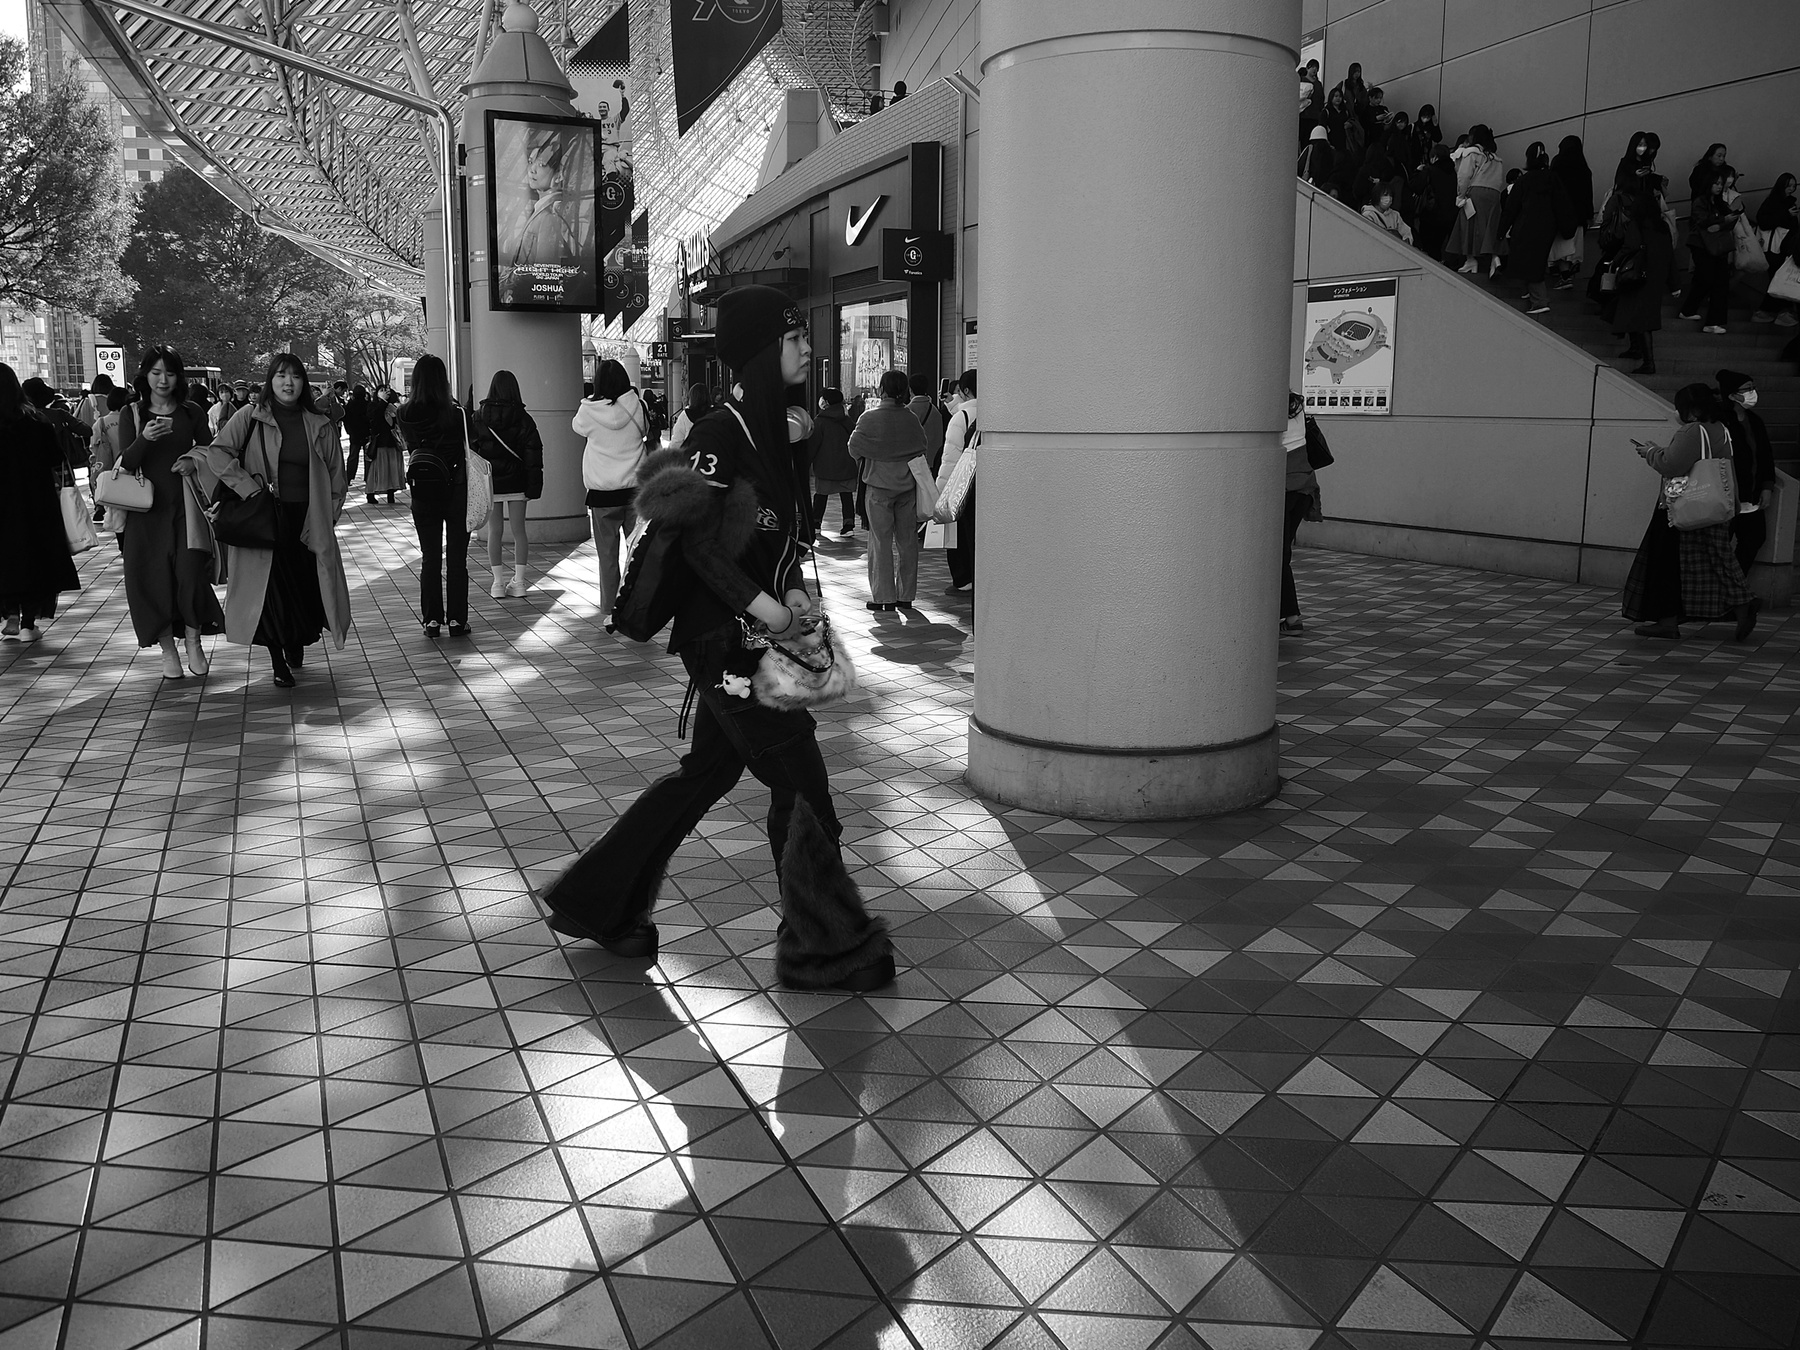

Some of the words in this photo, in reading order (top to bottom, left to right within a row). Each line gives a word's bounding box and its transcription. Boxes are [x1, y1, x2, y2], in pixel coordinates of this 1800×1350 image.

[531, 284, 564, 292] JOSHUA
[657, 343, 668, 353] 21
[690, 451, 718, 475] 13
